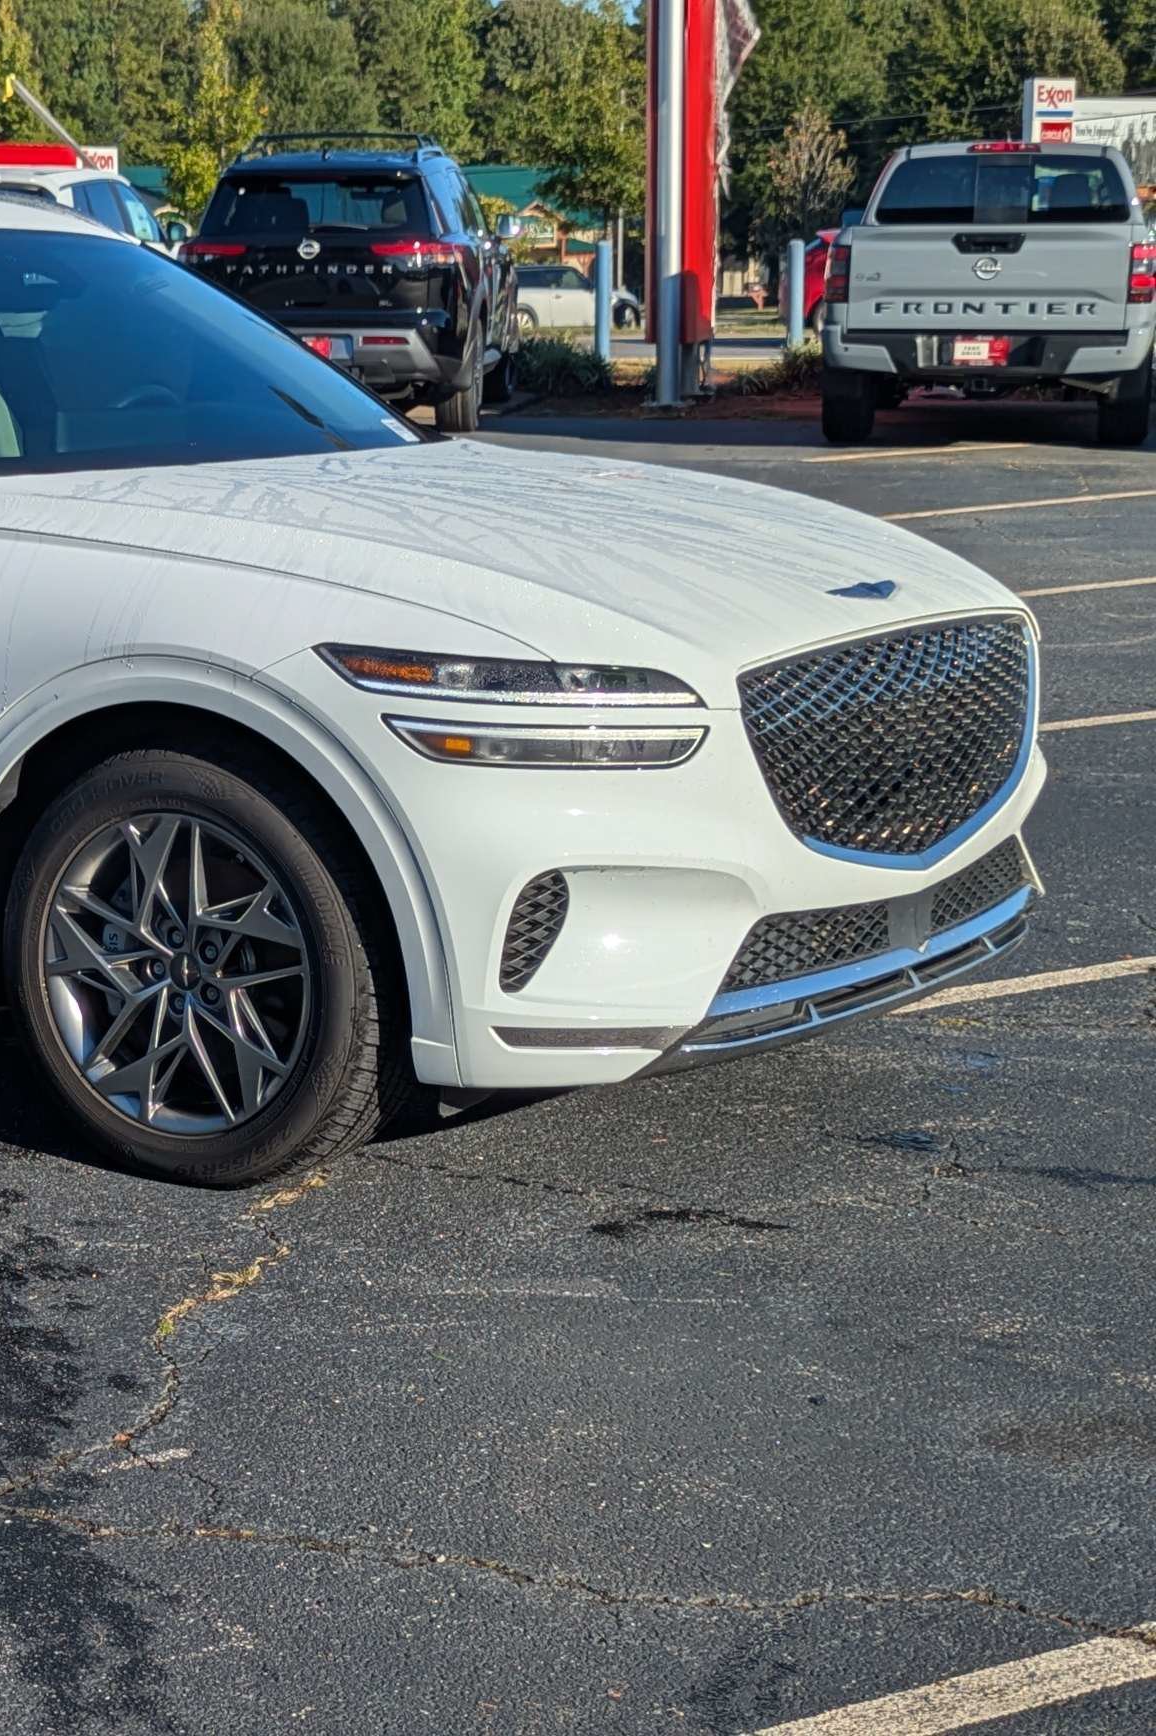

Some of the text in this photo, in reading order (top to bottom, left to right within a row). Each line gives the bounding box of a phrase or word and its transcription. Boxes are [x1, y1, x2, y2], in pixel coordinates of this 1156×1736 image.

[1037, 85, 1073, 109] Exxon
[226, 264, 393, 275] PATHFINDER
[873, 302, 1098, 316] FRONTIER
